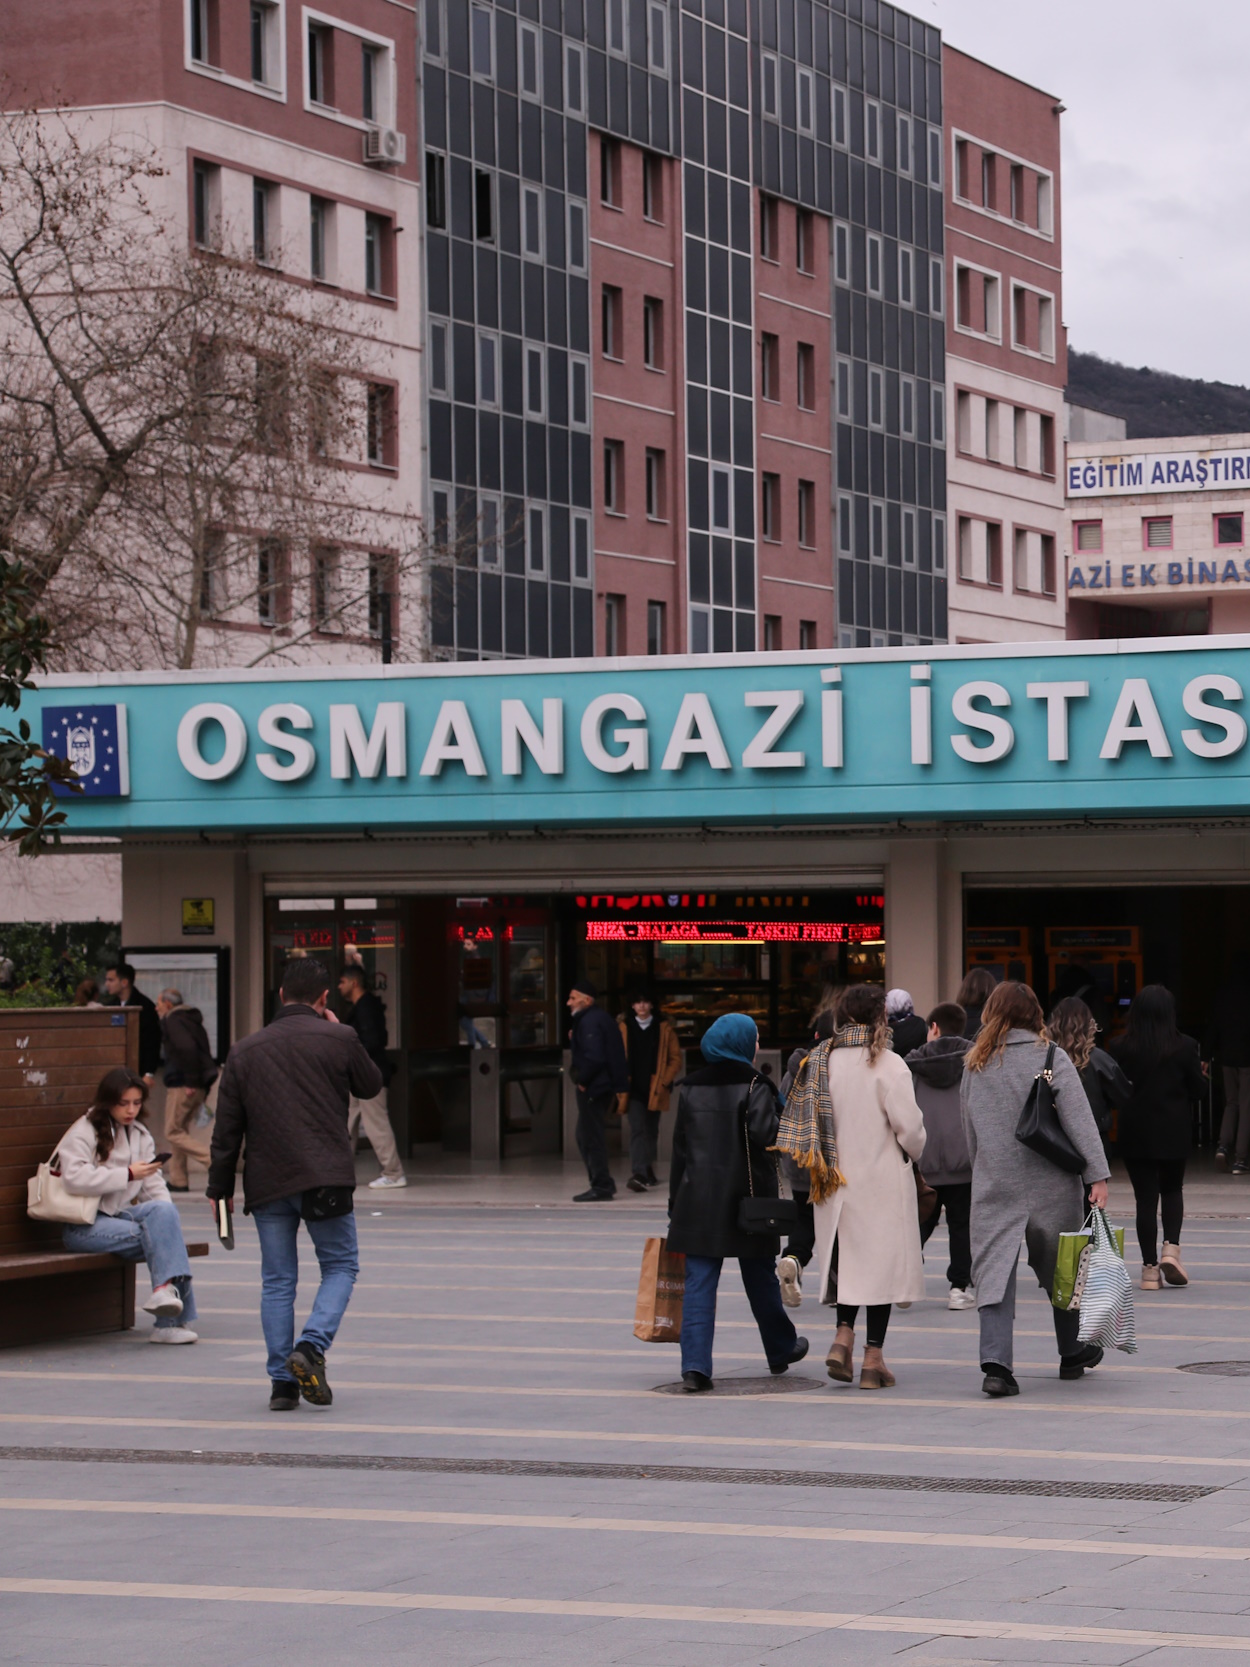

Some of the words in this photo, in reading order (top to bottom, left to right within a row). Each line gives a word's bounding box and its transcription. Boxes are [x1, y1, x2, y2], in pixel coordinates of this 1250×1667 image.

[1069, 459, 1143, 490] EĞİTİM
[1122, 563, 1156, 587] EK
[176, 665, 844, 782] OSMANGAZİ
[745, 925, 799, 939] TAŞKIN
[802, 925, 842, 939] FIRIN
